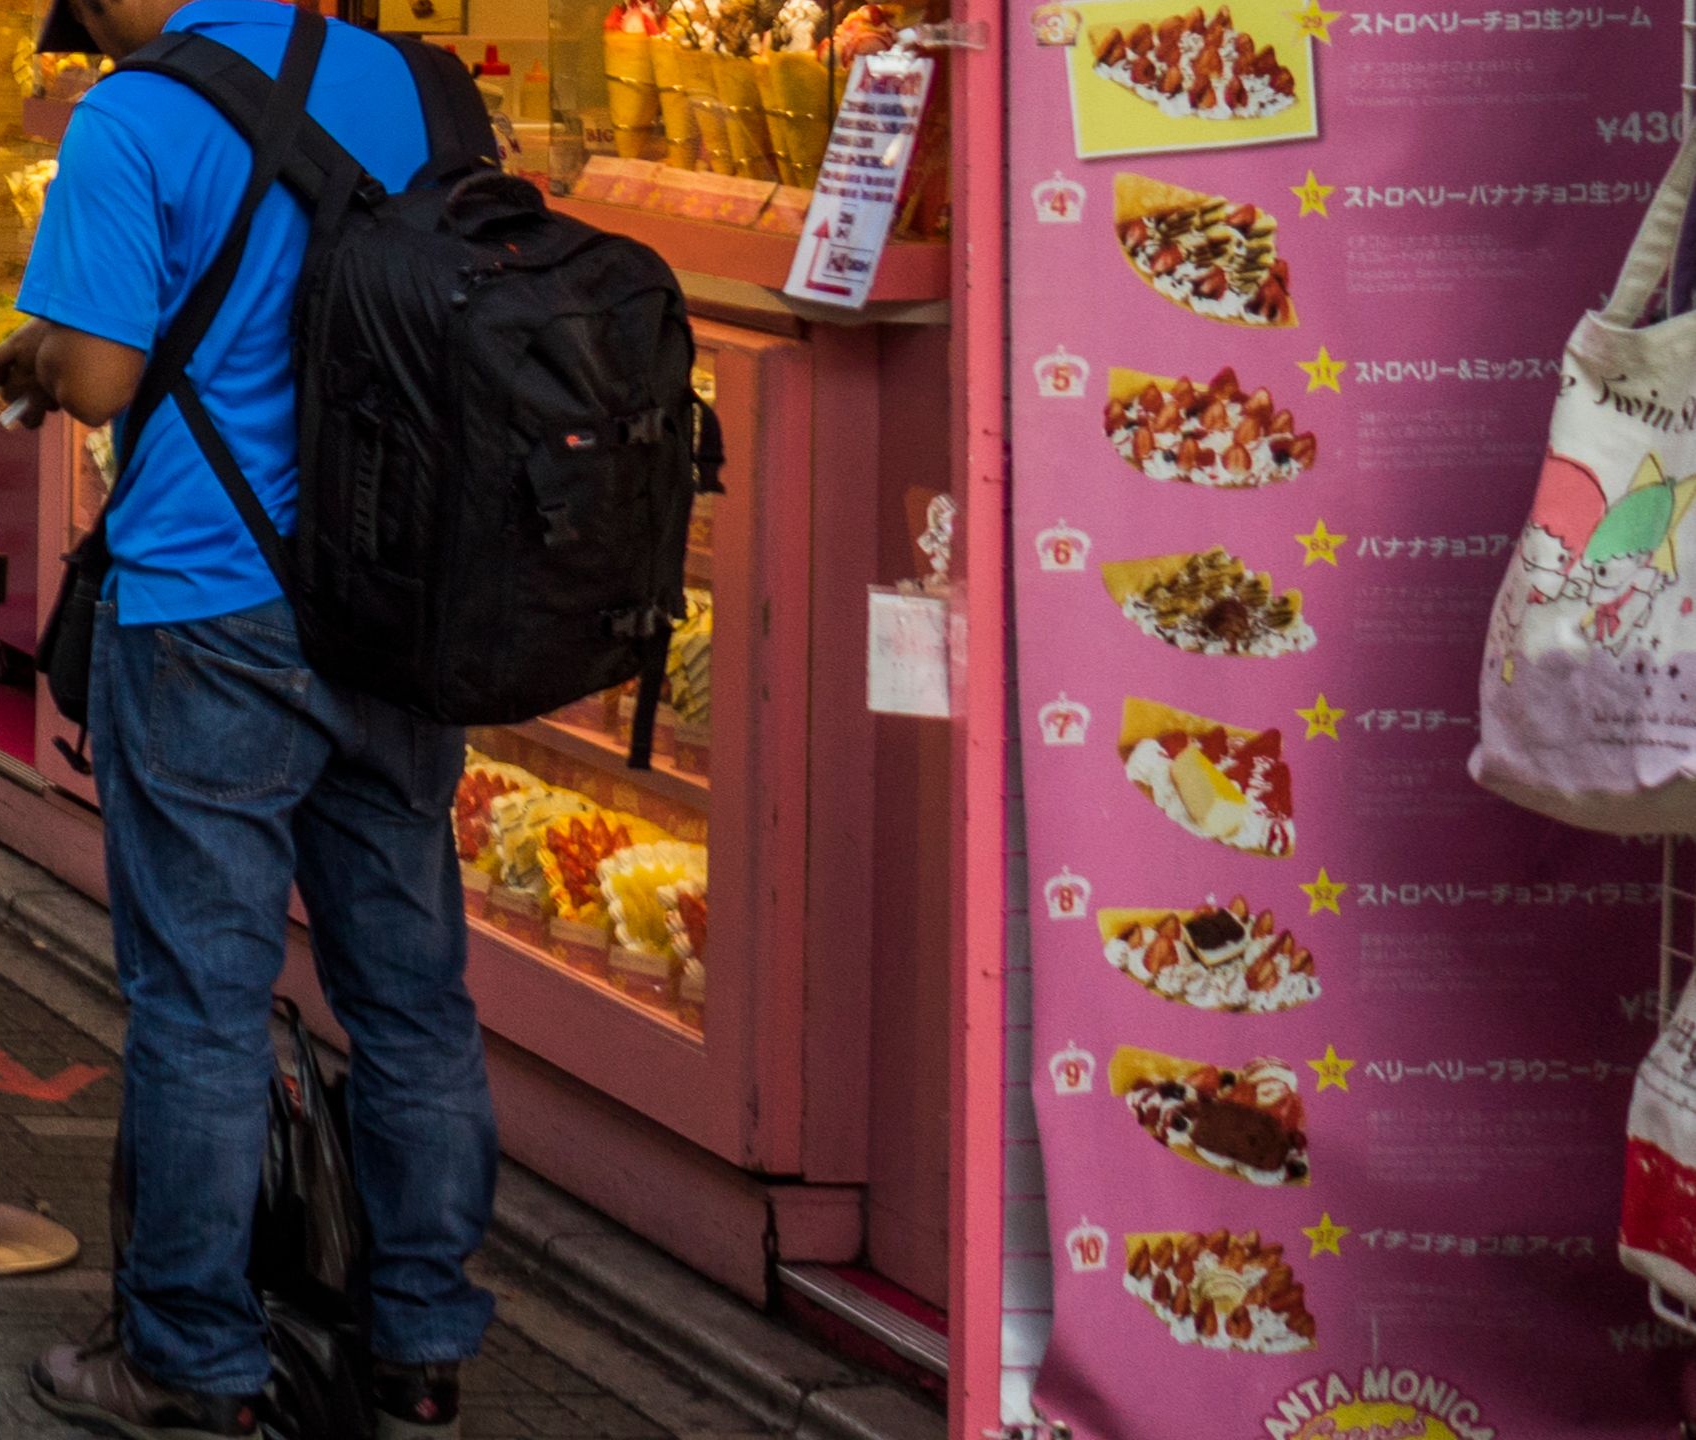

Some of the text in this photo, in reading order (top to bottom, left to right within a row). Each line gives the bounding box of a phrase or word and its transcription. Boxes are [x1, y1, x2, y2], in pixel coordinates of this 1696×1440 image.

[1350, 7, 1651, 38] ストロベリーチョコ生クリーム
[1343, 182, 1659, 209] ストロベリーバナナチョコ生クリ
[1356, 534, 1517, 560] バナナチョコア
